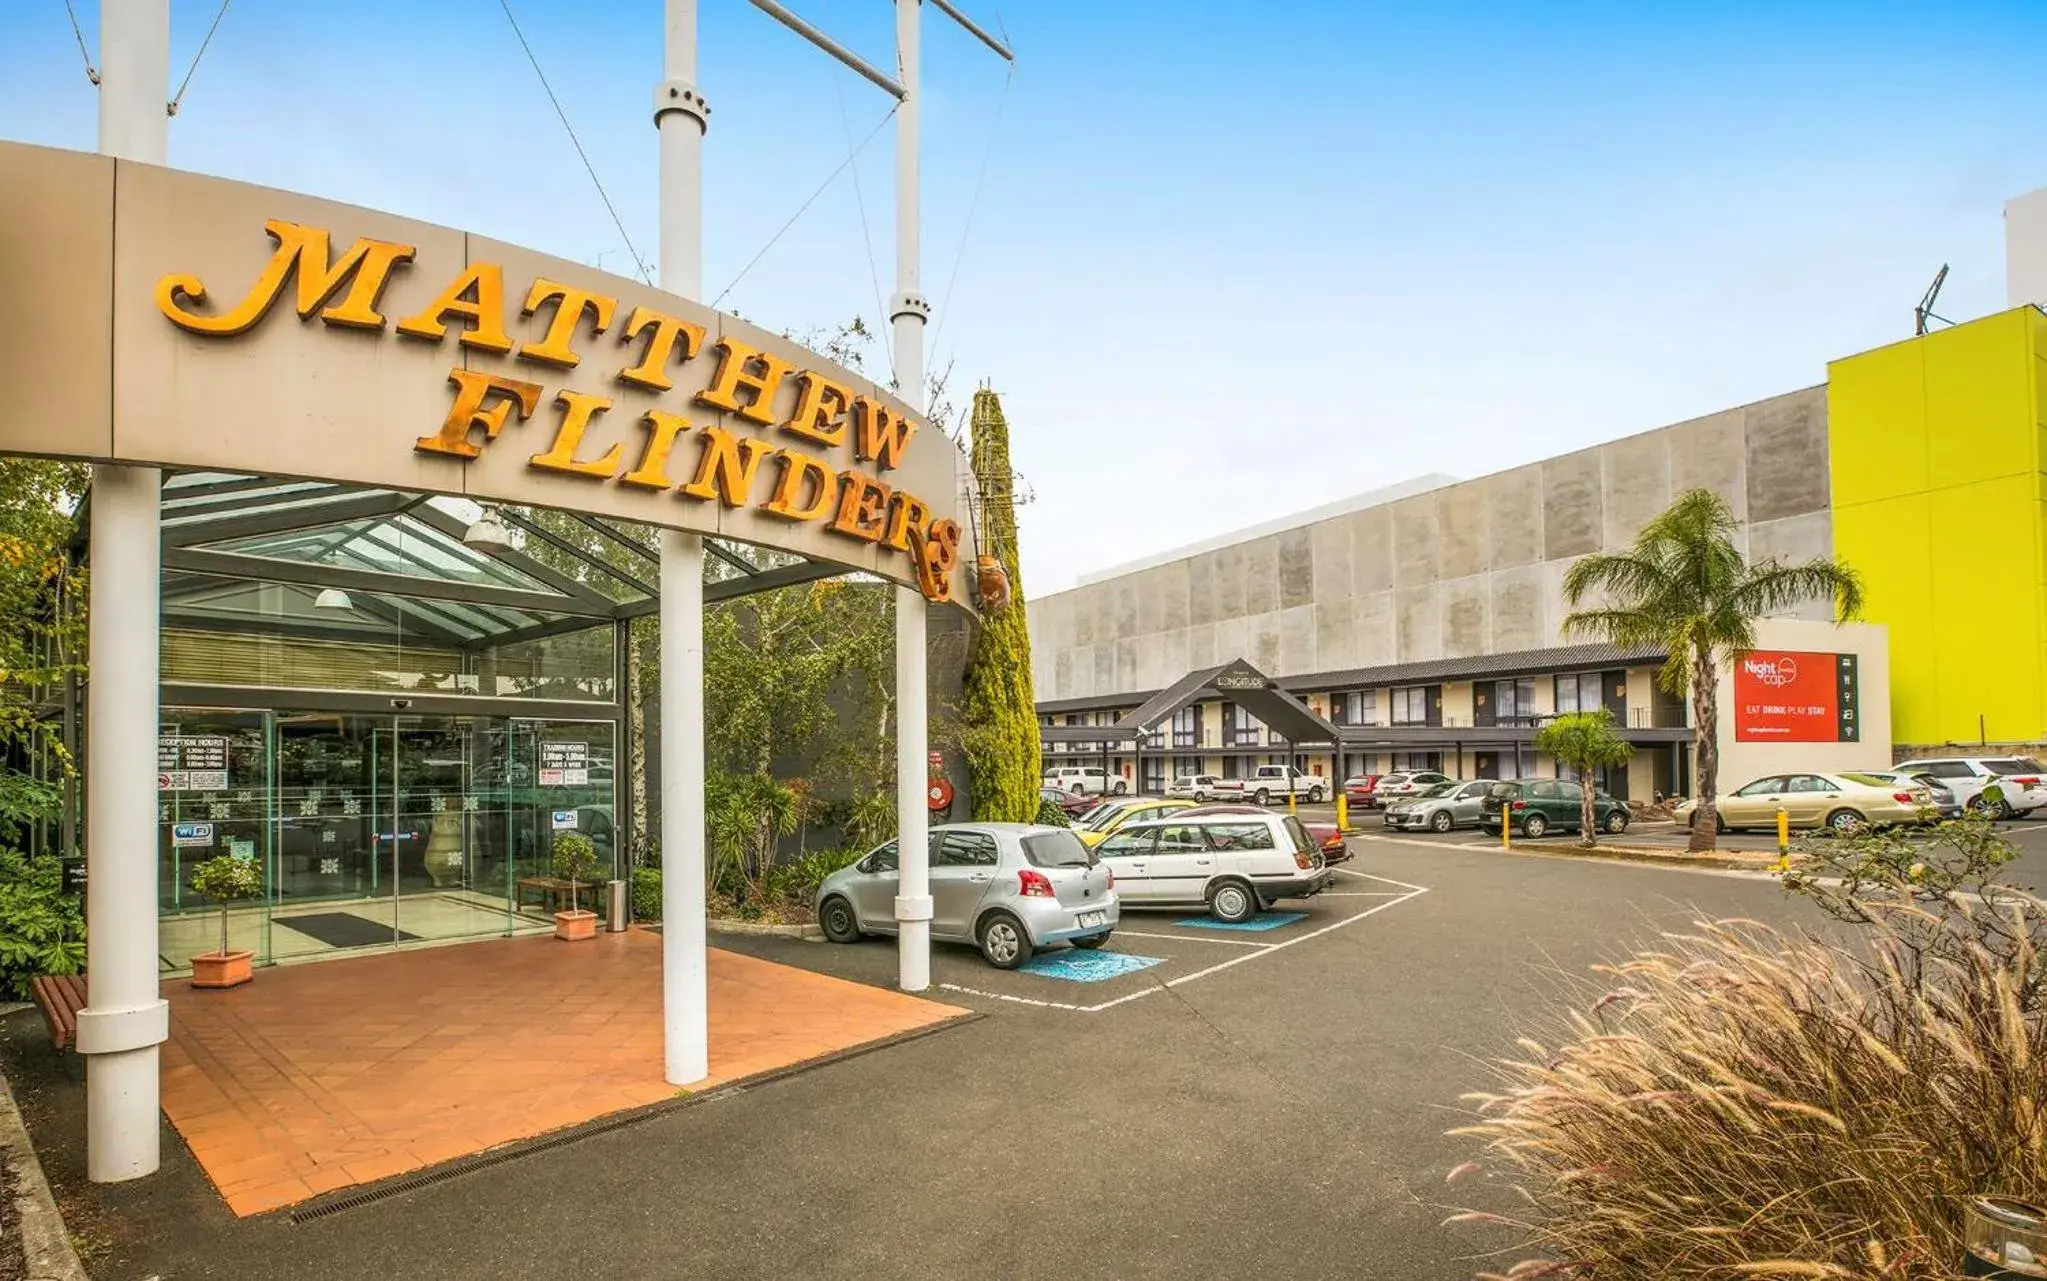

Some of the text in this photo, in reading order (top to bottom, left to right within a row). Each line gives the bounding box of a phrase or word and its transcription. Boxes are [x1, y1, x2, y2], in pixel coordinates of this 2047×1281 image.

[156, 219, 918, 470] MATTHEW
[413, 367, 961, 603] FLINDERS
[1744, 660, 1777, 679] Night
[1763, 674, 1785, 688] cap
[1746, 705, 1826, 716] EAT DRINK PLAY STAY
[159, 738, 197, 746] ECEPTION
